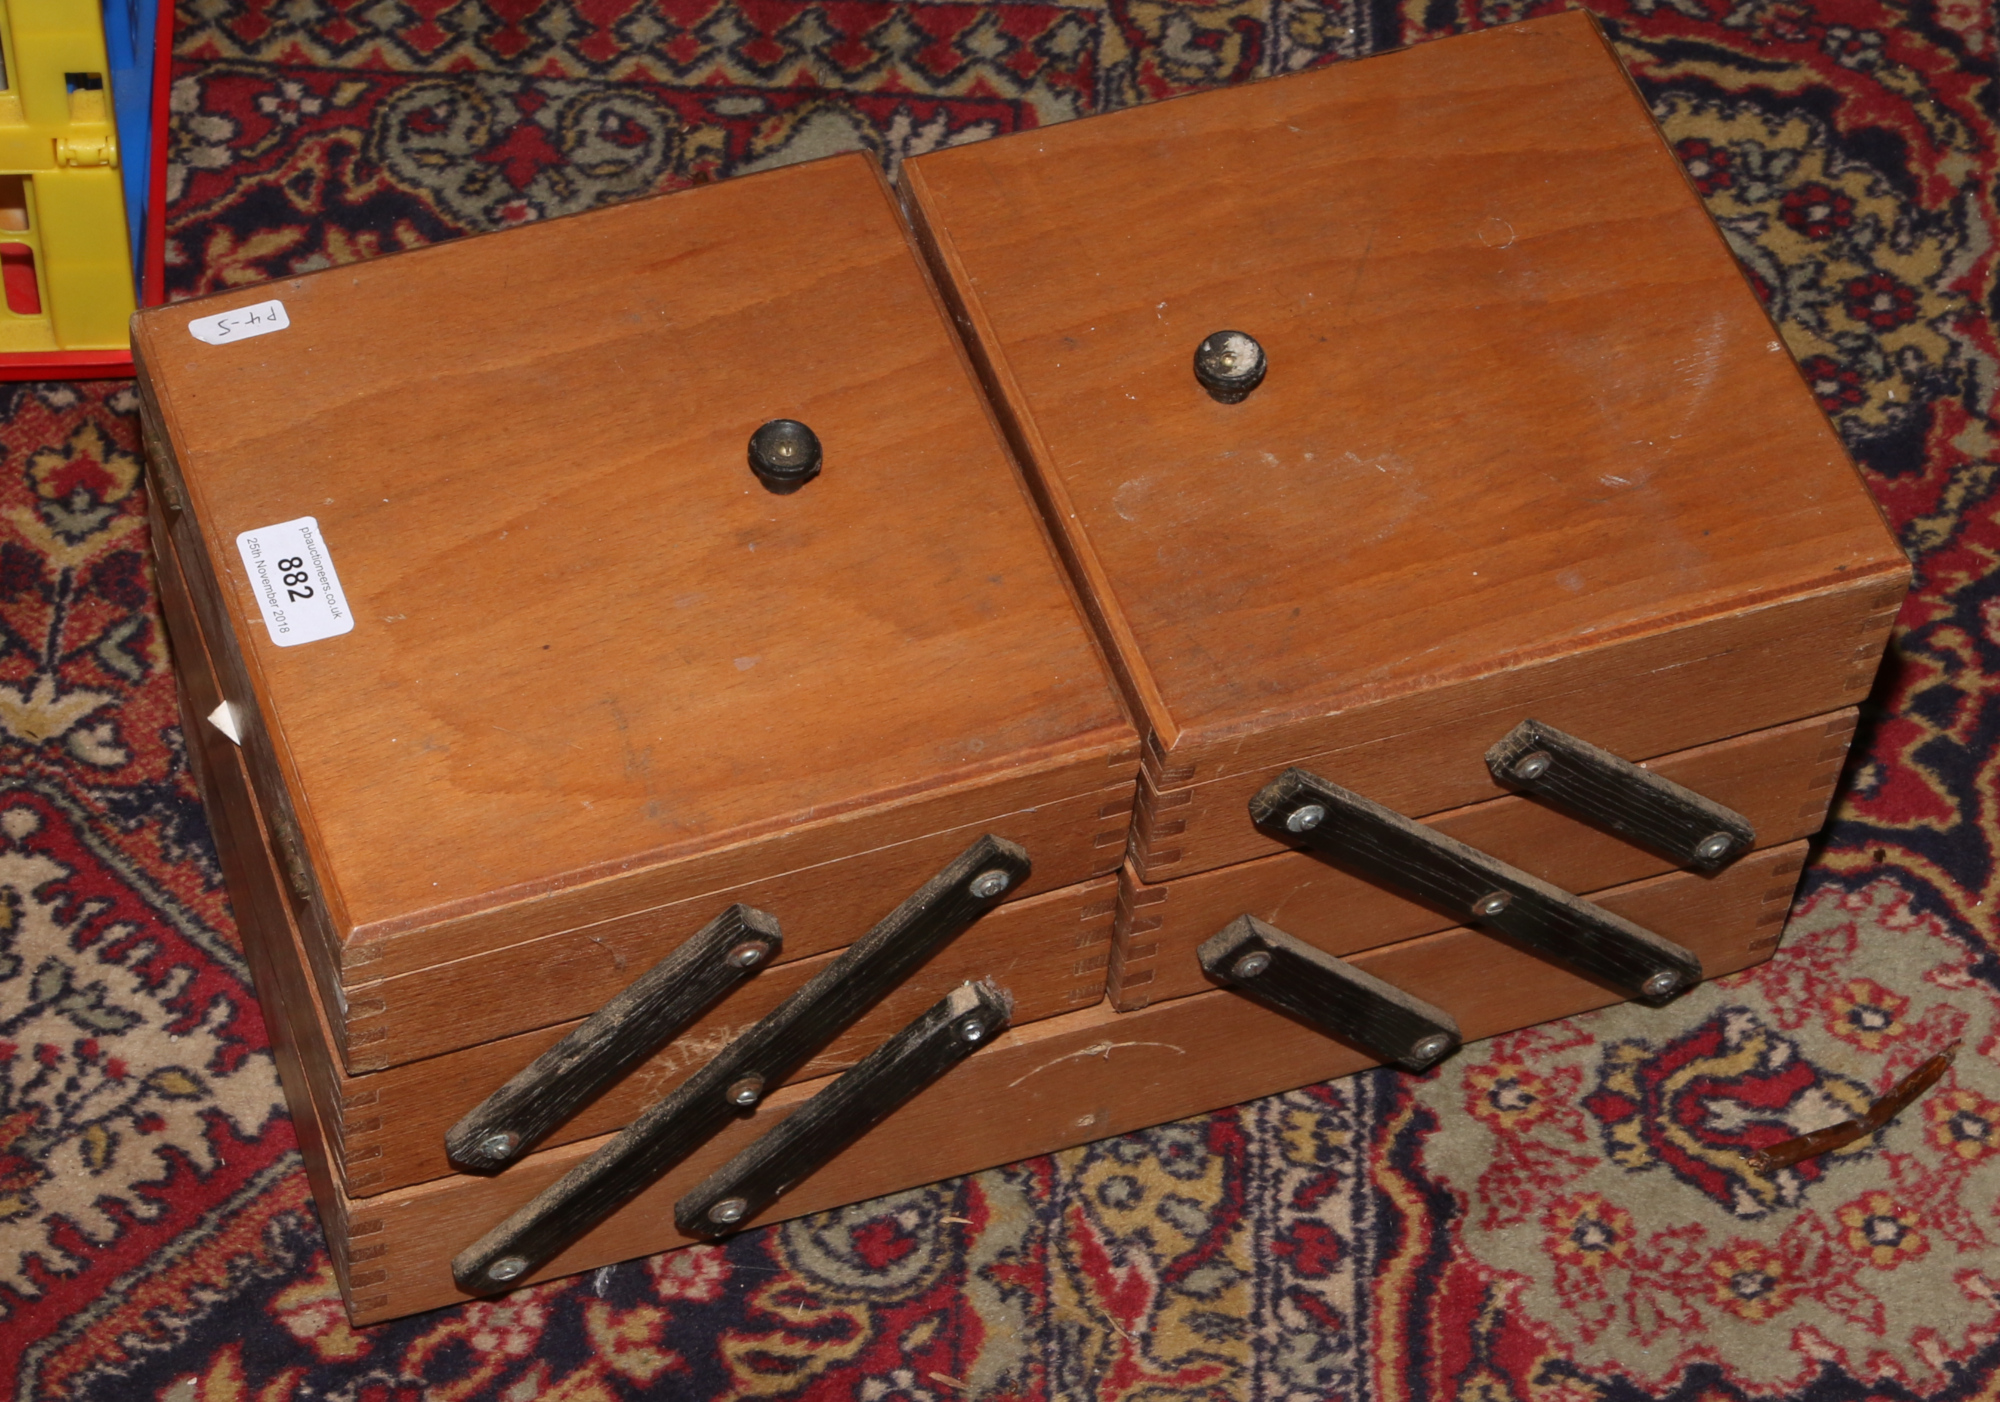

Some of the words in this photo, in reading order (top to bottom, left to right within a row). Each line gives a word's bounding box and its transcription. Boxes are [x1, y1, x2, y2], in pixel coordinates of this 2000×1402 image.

[247, 537, 261, 559] 25th
[255, 559, 279, 609] November
[273, 610, 290, 634] 2018
[278, 556, 314, 603] 882
[298, 526, 343, 620] pbauctioneers.co.uk
